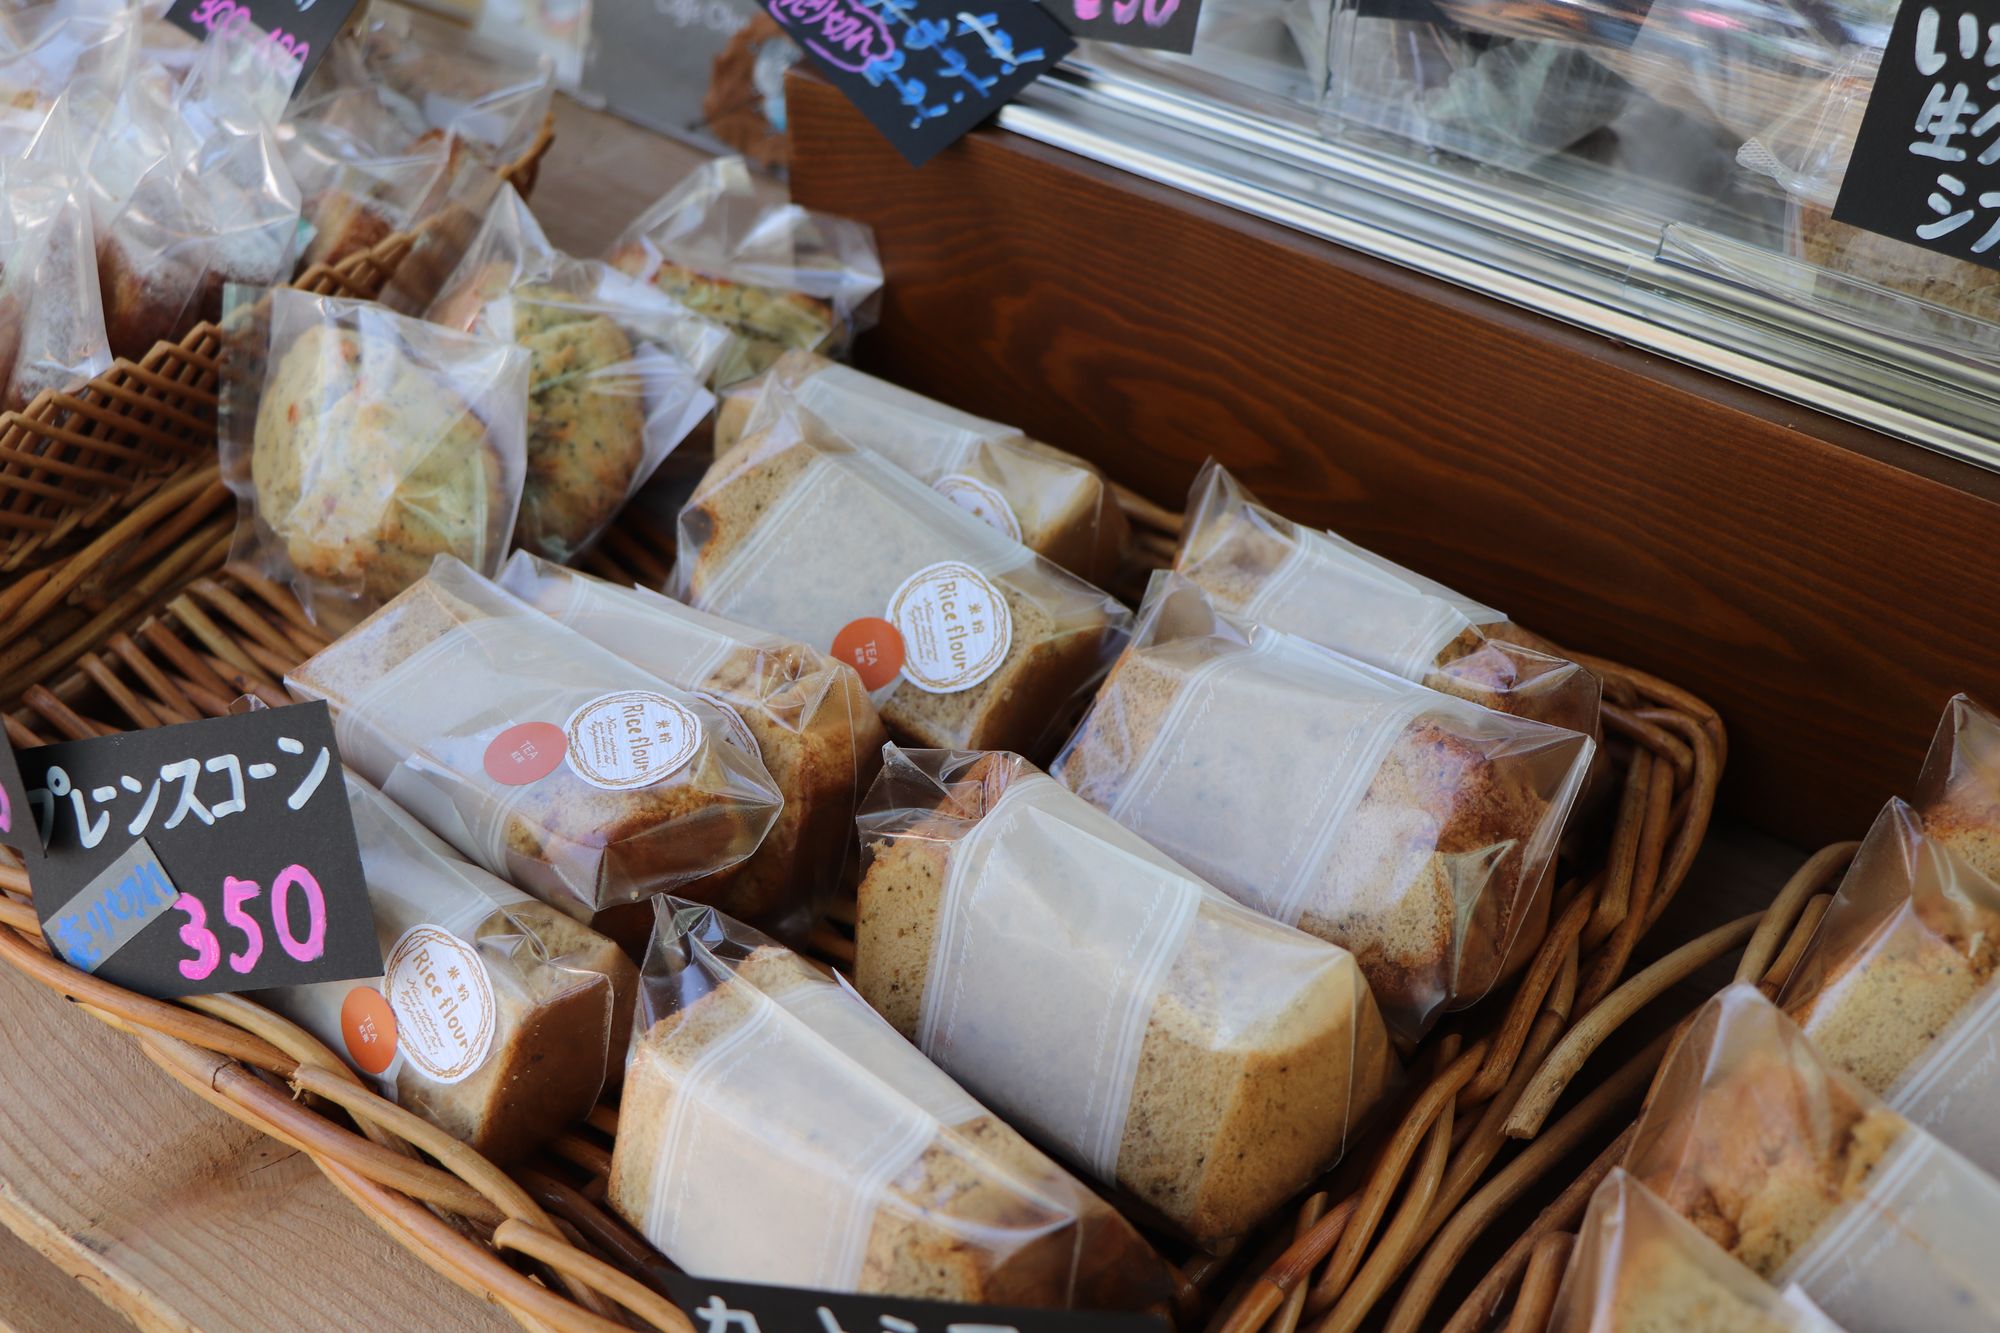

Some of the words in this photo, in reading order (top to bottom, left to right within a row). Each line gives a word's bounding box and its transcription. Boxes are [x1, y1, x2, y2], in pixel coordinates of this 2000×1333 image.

[937, 581, 958, 622] Rice
[865, 640, 878, 666] TEA
[946, 625, 968, 670] flour
[622, 703, 644, 734] Rice
[520, 740, 538, 760] TEA
[629, 737, 654, 772] flour
[27, 737, 330, 857] プレーンスコーン
[173, 864, 327, 980] 350
[412, 948, 443, 997] Rice
[438, 996, 468, 1049] flour
[447, 965, 470, 1002] 米粉
[364, 1014, 378, 1043] TEA
